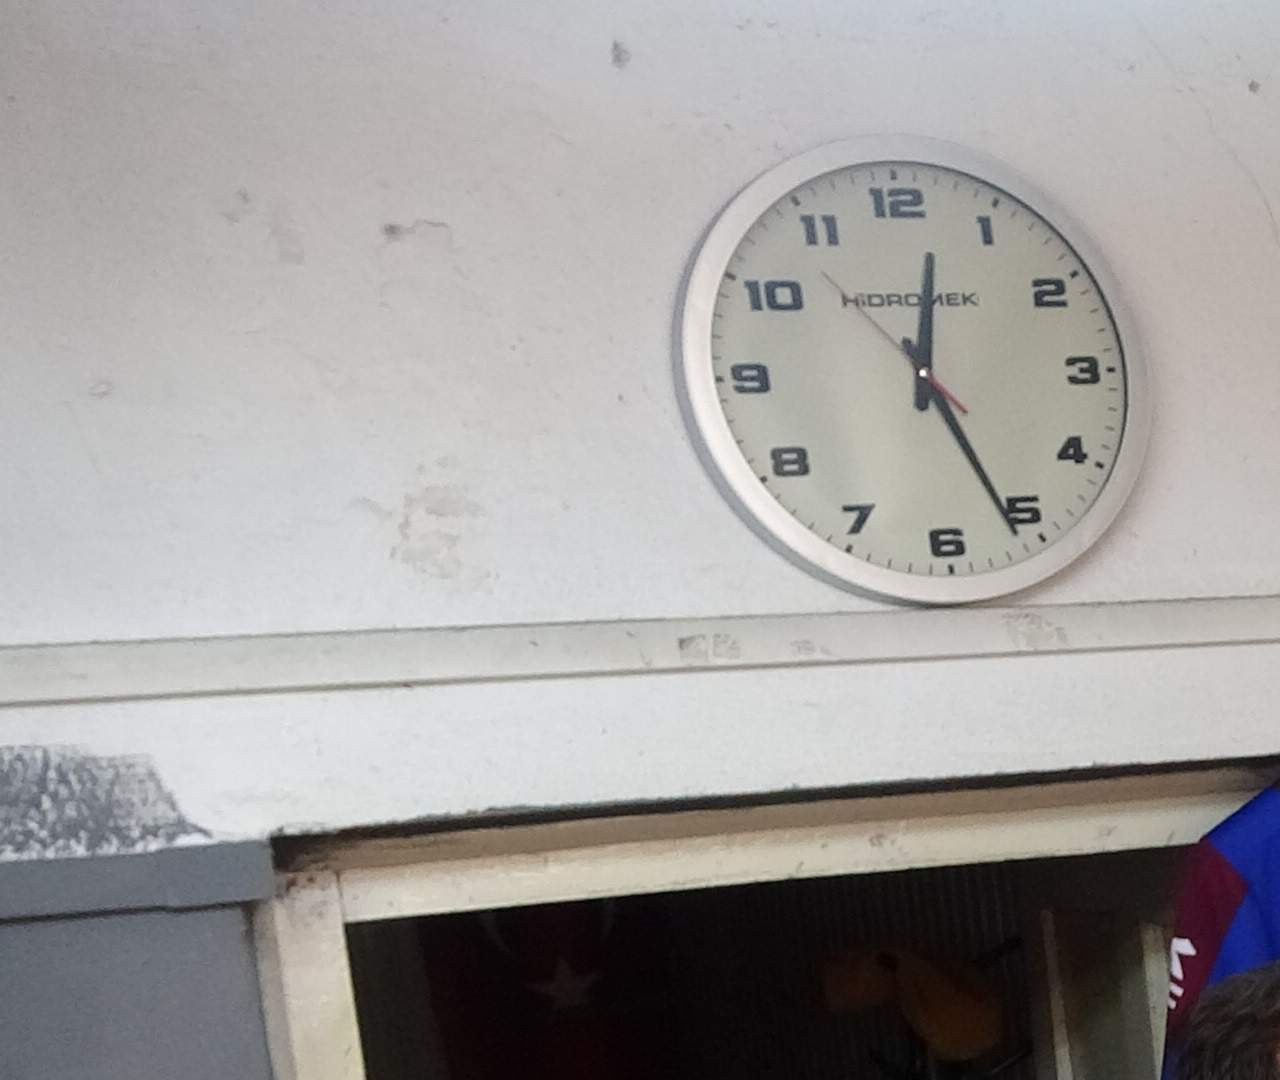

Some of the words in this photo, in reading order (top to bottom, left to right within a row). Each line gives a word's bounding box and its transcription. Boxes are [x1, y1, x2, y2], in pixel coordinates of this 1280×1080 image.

[869, 187, 926, 218] 12
[800, 215, 839, 246] 11
[976, 215, 994, 246] 1
[743, 280, 804, 311] 10
[1031, 278, 1069, 309] 2
[730, 363, 771, 394] 9
[1065, 356, 1100, 385] 3
[770, 446, 811, 478] 8
[1056, 436, 1088, 464] 4
[842, 504, 876, 535] 7
[1005, 495, 1042, 525] 5
[929, 528, 967, 558] 6
